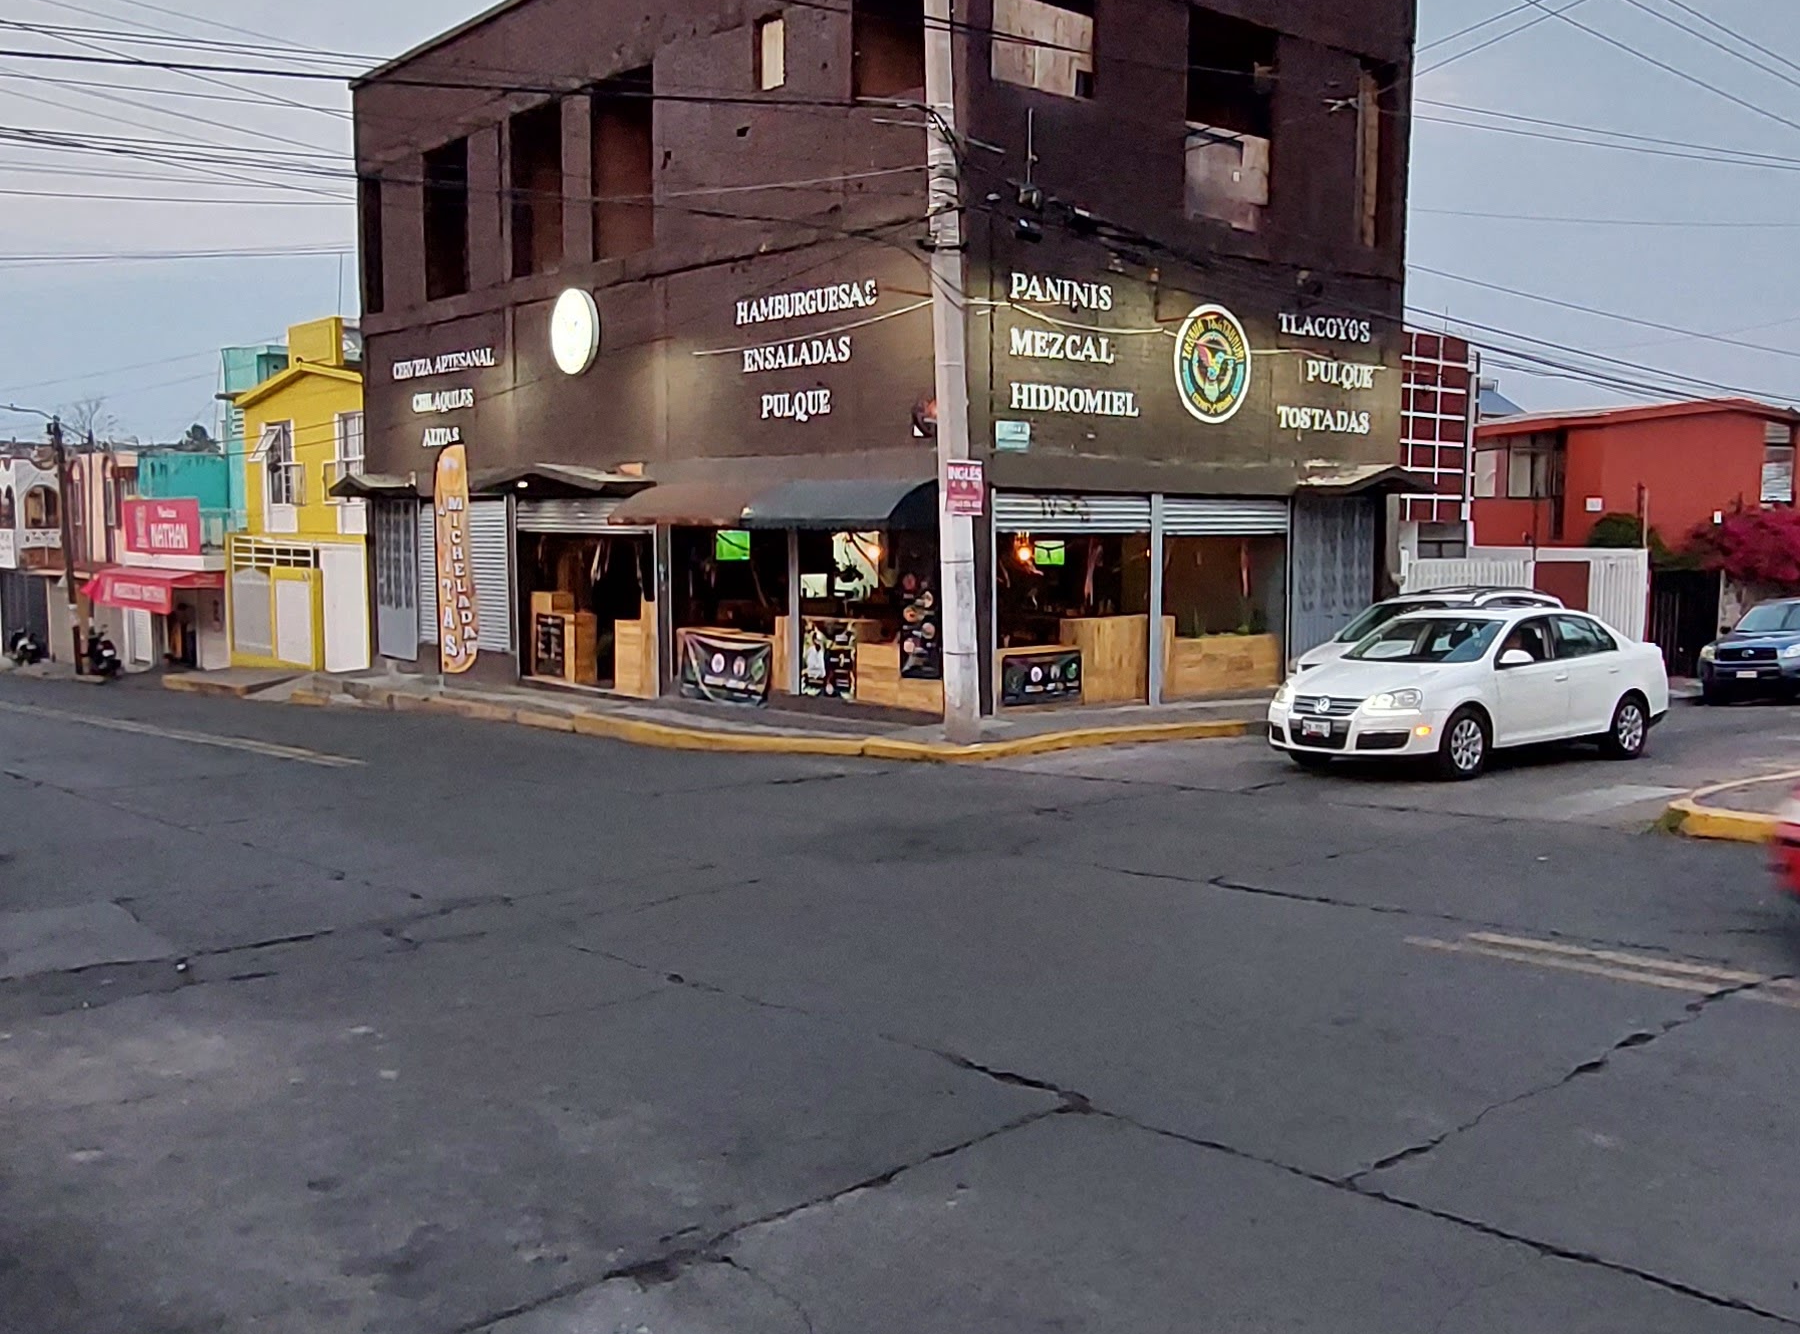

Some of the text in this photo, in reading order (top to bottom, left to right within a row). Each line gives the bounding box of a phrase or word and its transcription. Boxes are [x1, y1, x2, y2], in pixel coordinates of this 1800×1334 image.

[735, 279, 878, 325] HAMBURGUESAS
[1010, 272, 1112, 311] PANINIS
[1278, 313, 1370, 343] TLACOYOS
[743, 336, 852, 372] ENSALADAS
[1010, 327, 1115, 365] MEZCAL
[393, 358, 433, 380] CERVEZA
[1306, 359, 1374, 390] PULQUE
[412, 389, 474, 413] CHILAQUILES
[761, 389, 831, 422] PULQUE
[1010, 382, 1140, 417] HIDROMIEL
[1277, 405, 1370, 434] TOSTADAS
[422, 427, 460, 447] ALITAS
